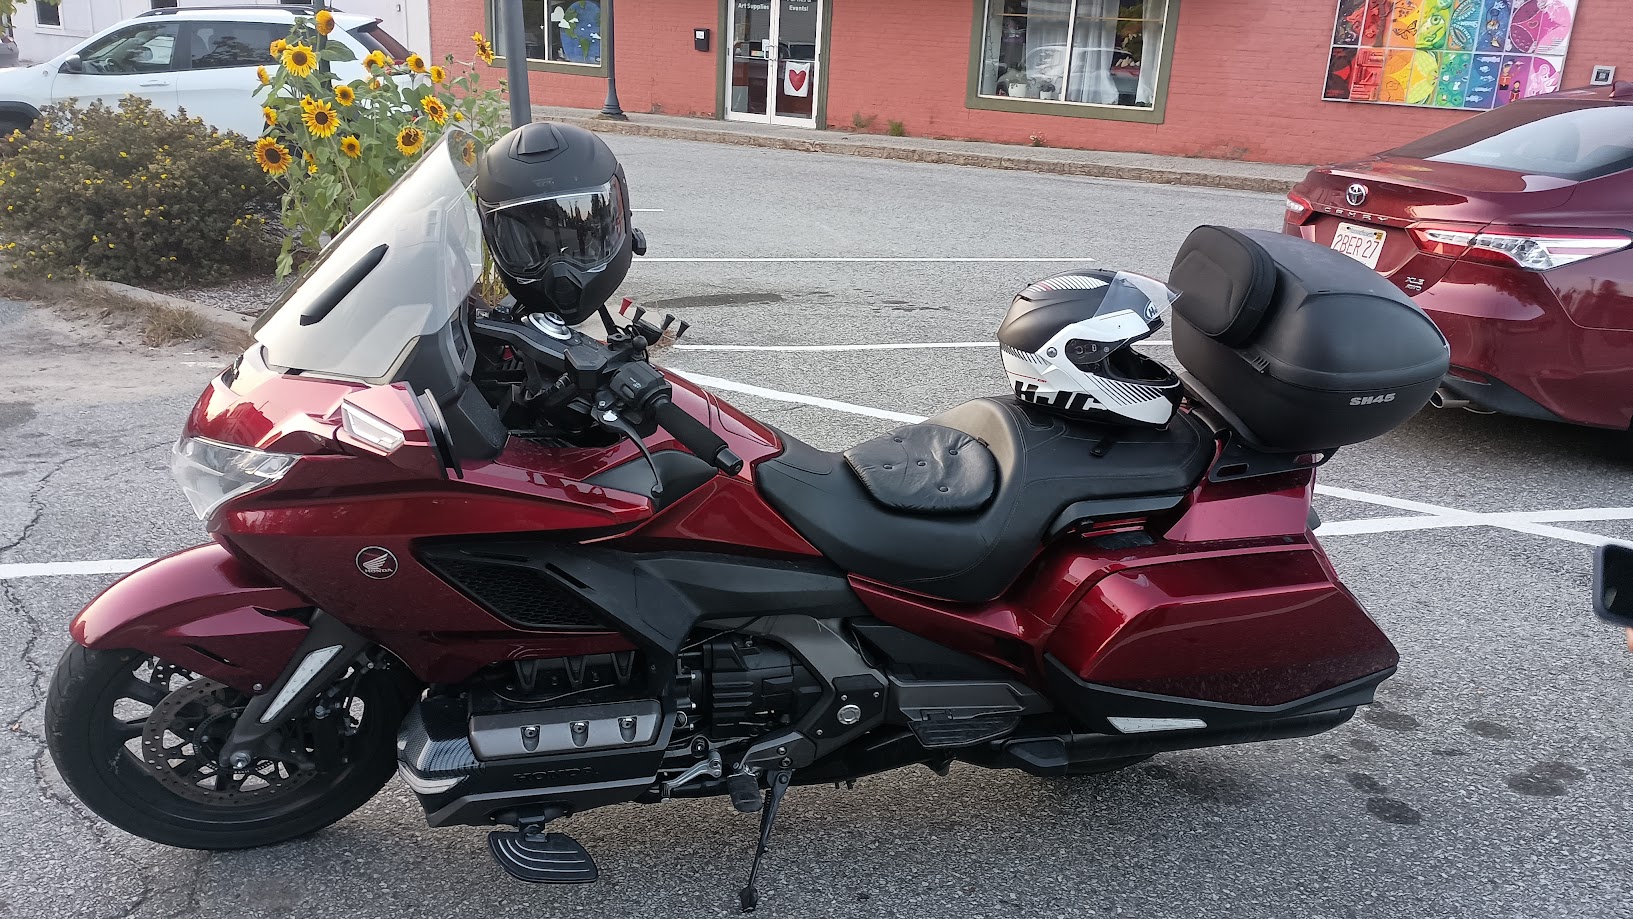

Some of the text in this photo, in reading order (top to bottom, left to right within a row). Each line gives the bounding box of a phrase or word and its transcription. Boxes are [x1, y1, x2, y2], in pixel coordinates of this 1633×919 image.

[747, 3, 770, 11] Supplies
[788, 4, 809, 12] Events!
[1324, 206, 1389, 221] CAMRY
[1333, 233, 1363, 257] 2BER
[1362, 239, 1380, 260] 27
[1349, 392, 1397, 406] SH45
[512, 766, 600, 783] HONDA
